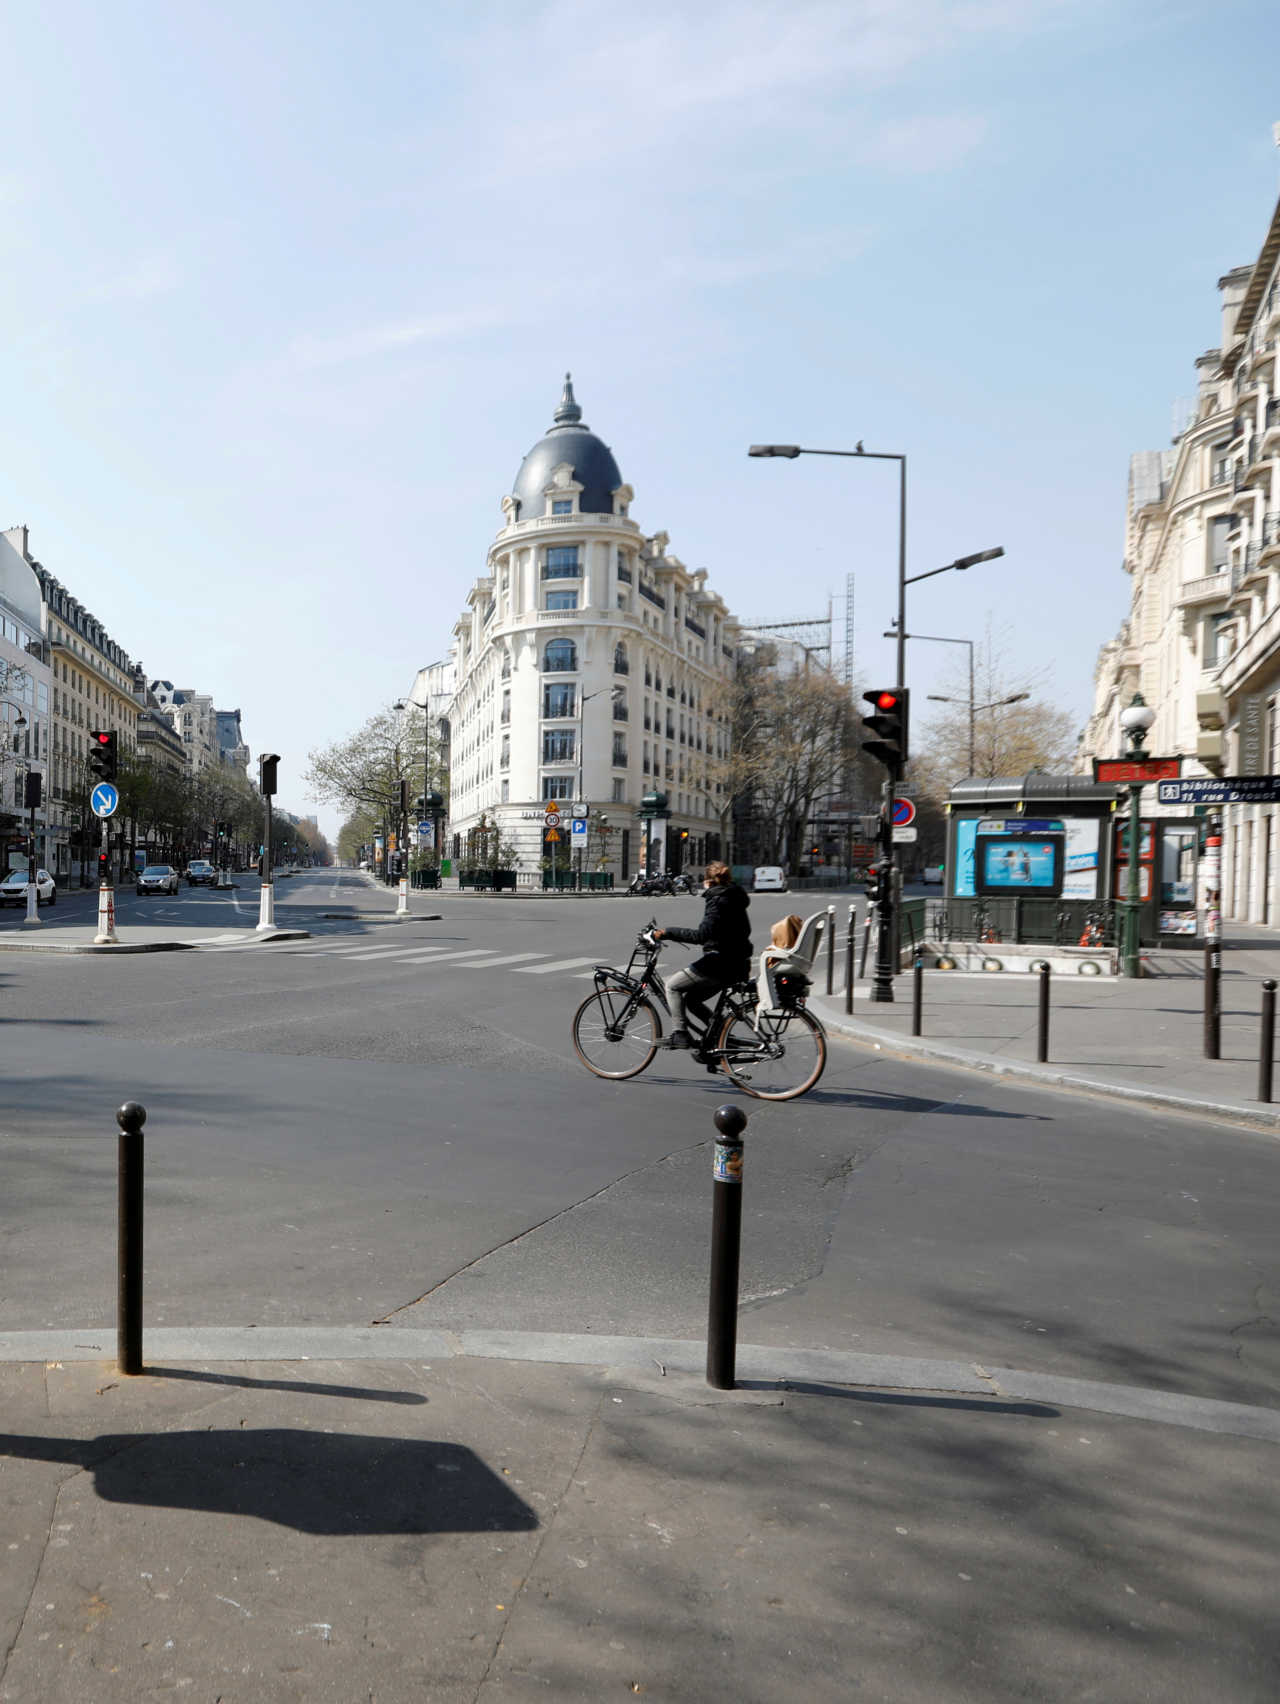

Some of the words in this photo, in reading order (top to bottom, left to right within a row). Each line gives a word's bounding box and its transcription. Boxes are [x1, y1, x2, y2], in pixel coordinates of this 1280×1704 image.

[1180, 778, 1267, 791] bibliothèque
[1201, 793, 1225, 802] rue
[1228, 790, 1277, 801] Drouot
[575, 822, 584, 833] P
